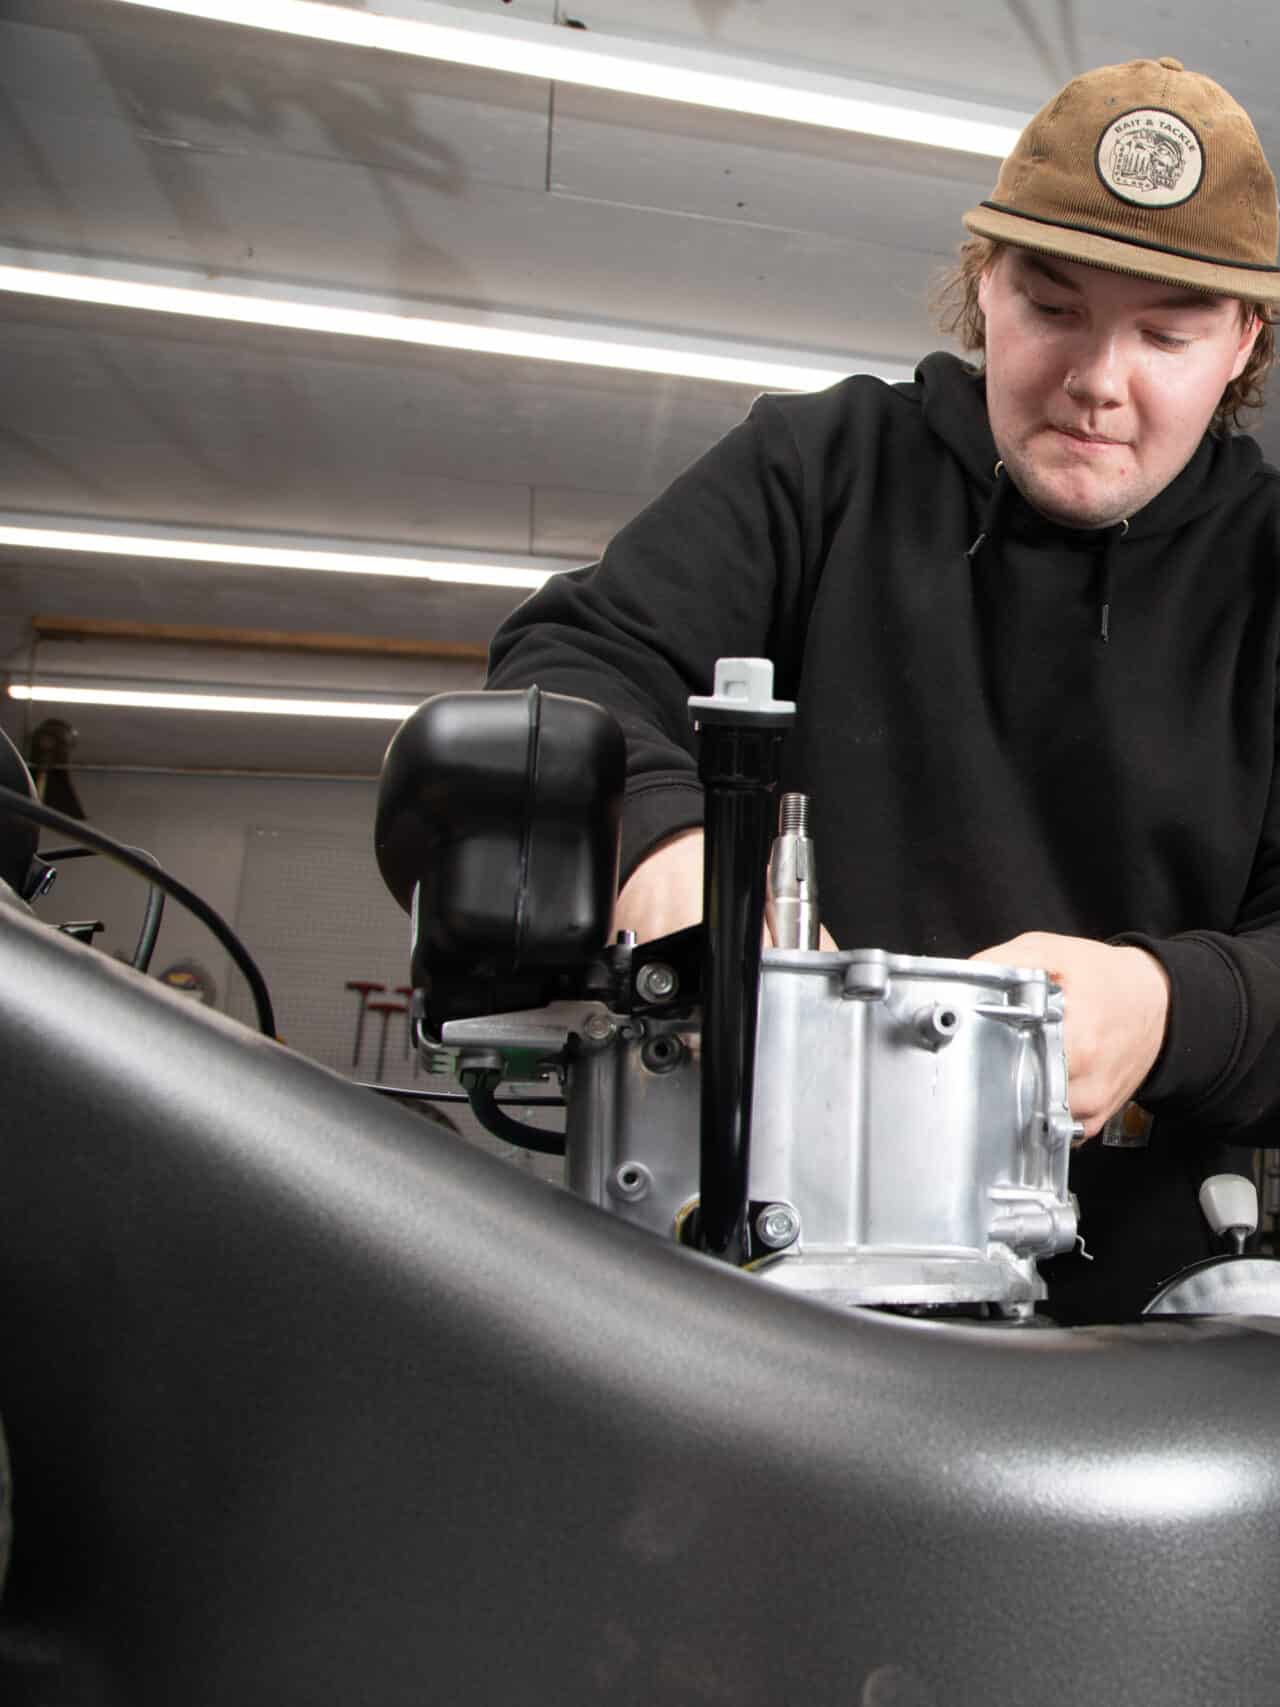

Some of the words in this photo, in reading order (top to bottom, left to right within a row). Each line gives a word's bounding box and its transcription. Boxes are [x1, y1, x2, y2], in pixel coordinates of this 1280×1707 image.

[1114, 119, 1141, 134] BAIT
[1145, 119, 1154, 127] &
[1158, 120, 1197, 152] TACKLE
